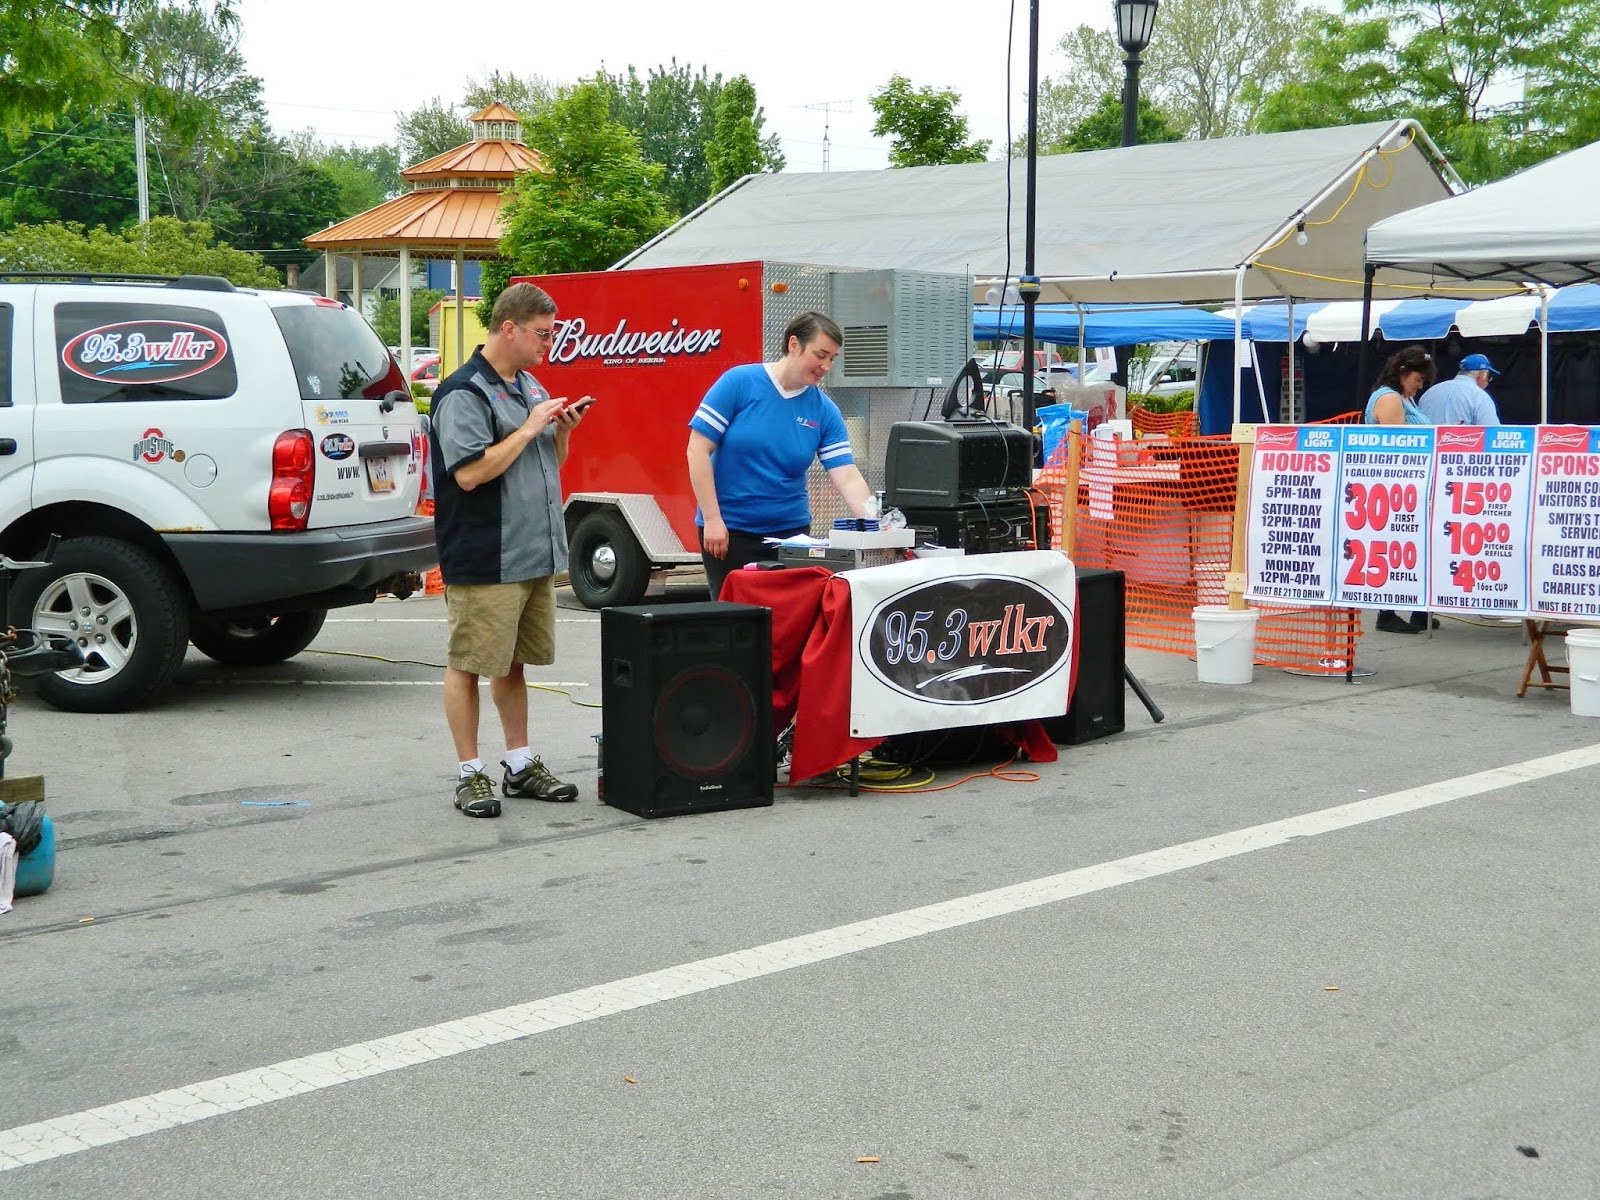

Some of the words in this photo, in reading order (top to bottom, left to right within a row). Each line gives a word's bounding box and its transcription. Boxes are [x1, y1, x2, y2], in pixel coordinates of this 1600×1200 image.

[549, 318, 722, 363] Budweiser
[80, 333, 145, 363] 95.3
[145, 332, 215, 361] wlkr
[1308, 431, 1330, 439] BUD
[1348, 434, 1380, 446] BUD
[1381, 435, 1428, 448] LIGHT
[1497, 432, 1521, 440] BUD
[1304, 438, 1334, 448] LIGHT
[1492, 440, 1526, 449] LIGHT
[1262, 453, 1331, 473] HOURS
[1345, 454, 1367, 464] BUD
[1368, 454, 1400, 465] LIGHT
[1402, 455, 1428, 465] ONLY
[1441, 454, 1465, 465] BUD,
[1469, 454, 1492, 465] BUD
[1495, 454, 1528, 466] LIGHT
[1541, 455, 1599, 476] SPONS
[1345, 469, 1349, 477] 1
[1351, 469, 1382, 478] GALLON
[1384, 470, 1425, 479] BUCKETS
[1446, 467, 1453, 476] &
[1456, 466, 1495, 477] SHOCK
[1498, 466, 1520, 477] TOP
[1274, 475, 1315, 487] FRIDAY
[1266, 487, 1321, 499] 5PM-1AM
[1546, 481, 1581, 493] HURON
[1585, 482, 1600, 494] CO
[1539, 495, 1587, 507] VISITORS
[1262, 503, 1322, 516] SATURDAY
[1262, 516, 1321, 529] 12PM-1AM
[1395, 514, 1415, 522] FIRST
[1548, 512, 1591, 526] SMITH'S
[1390, 523, 1419, 532] BUCKET
[1561, 527, 1600, 540] SERVIC
[1268, 531, 1314, 543] SUNDAY
[1261, 543, 1321, 556] 12PM-1AM
[1484, 543, 1513, 551] PITCHER
[1542, 545, 1584, 558] FREIGHT
[1485, 550, 1512, 558] REFILLS
[1265, 560, 1315, 573] MONDAY
[1552, 563, 1585, 576] GLASS
[1260, 572, 1320, 586] 12PM-4PM
[1390, 572, 1417, 582] REFILL
[1253, 586, 1272, 595] MUST
[1273, 587, 1283, 596] BE
[1283, 588, 1291, 597] 21
[1292, 588, 1302, 597] TO
[1303, 589, 1325, 599] DRINK
[1495, 584, 1508, 592] CUP
[1543, 582, 1595, 596] CHARLIE'S
[1342, 592, 1362, 601] MUST
[1363, 593, 1372, 602] BE
[1374, 594, 1383, 602] 21
[1383, 594, 1393, 603] TO
[1395, 594, 1418, 604] DRINK
[1438, 596, 1458, 606] MUST
[1460, 598, 1470, 607] BE
[1471, 599, 1480, 607] 21
[1482, 599, 1492, 608] TO
[1494, 599, 1518, 609] DRINK
[1538, 601, 1559, 611] MUST
[1562, 603, 1571, 612] BE
[1574, 603, 1583, 612] 21
[1585, 604, 1595, 613] TO
[885, 607, 968, 666] 95.3
[967, 603, 1055, 657] wlkr
